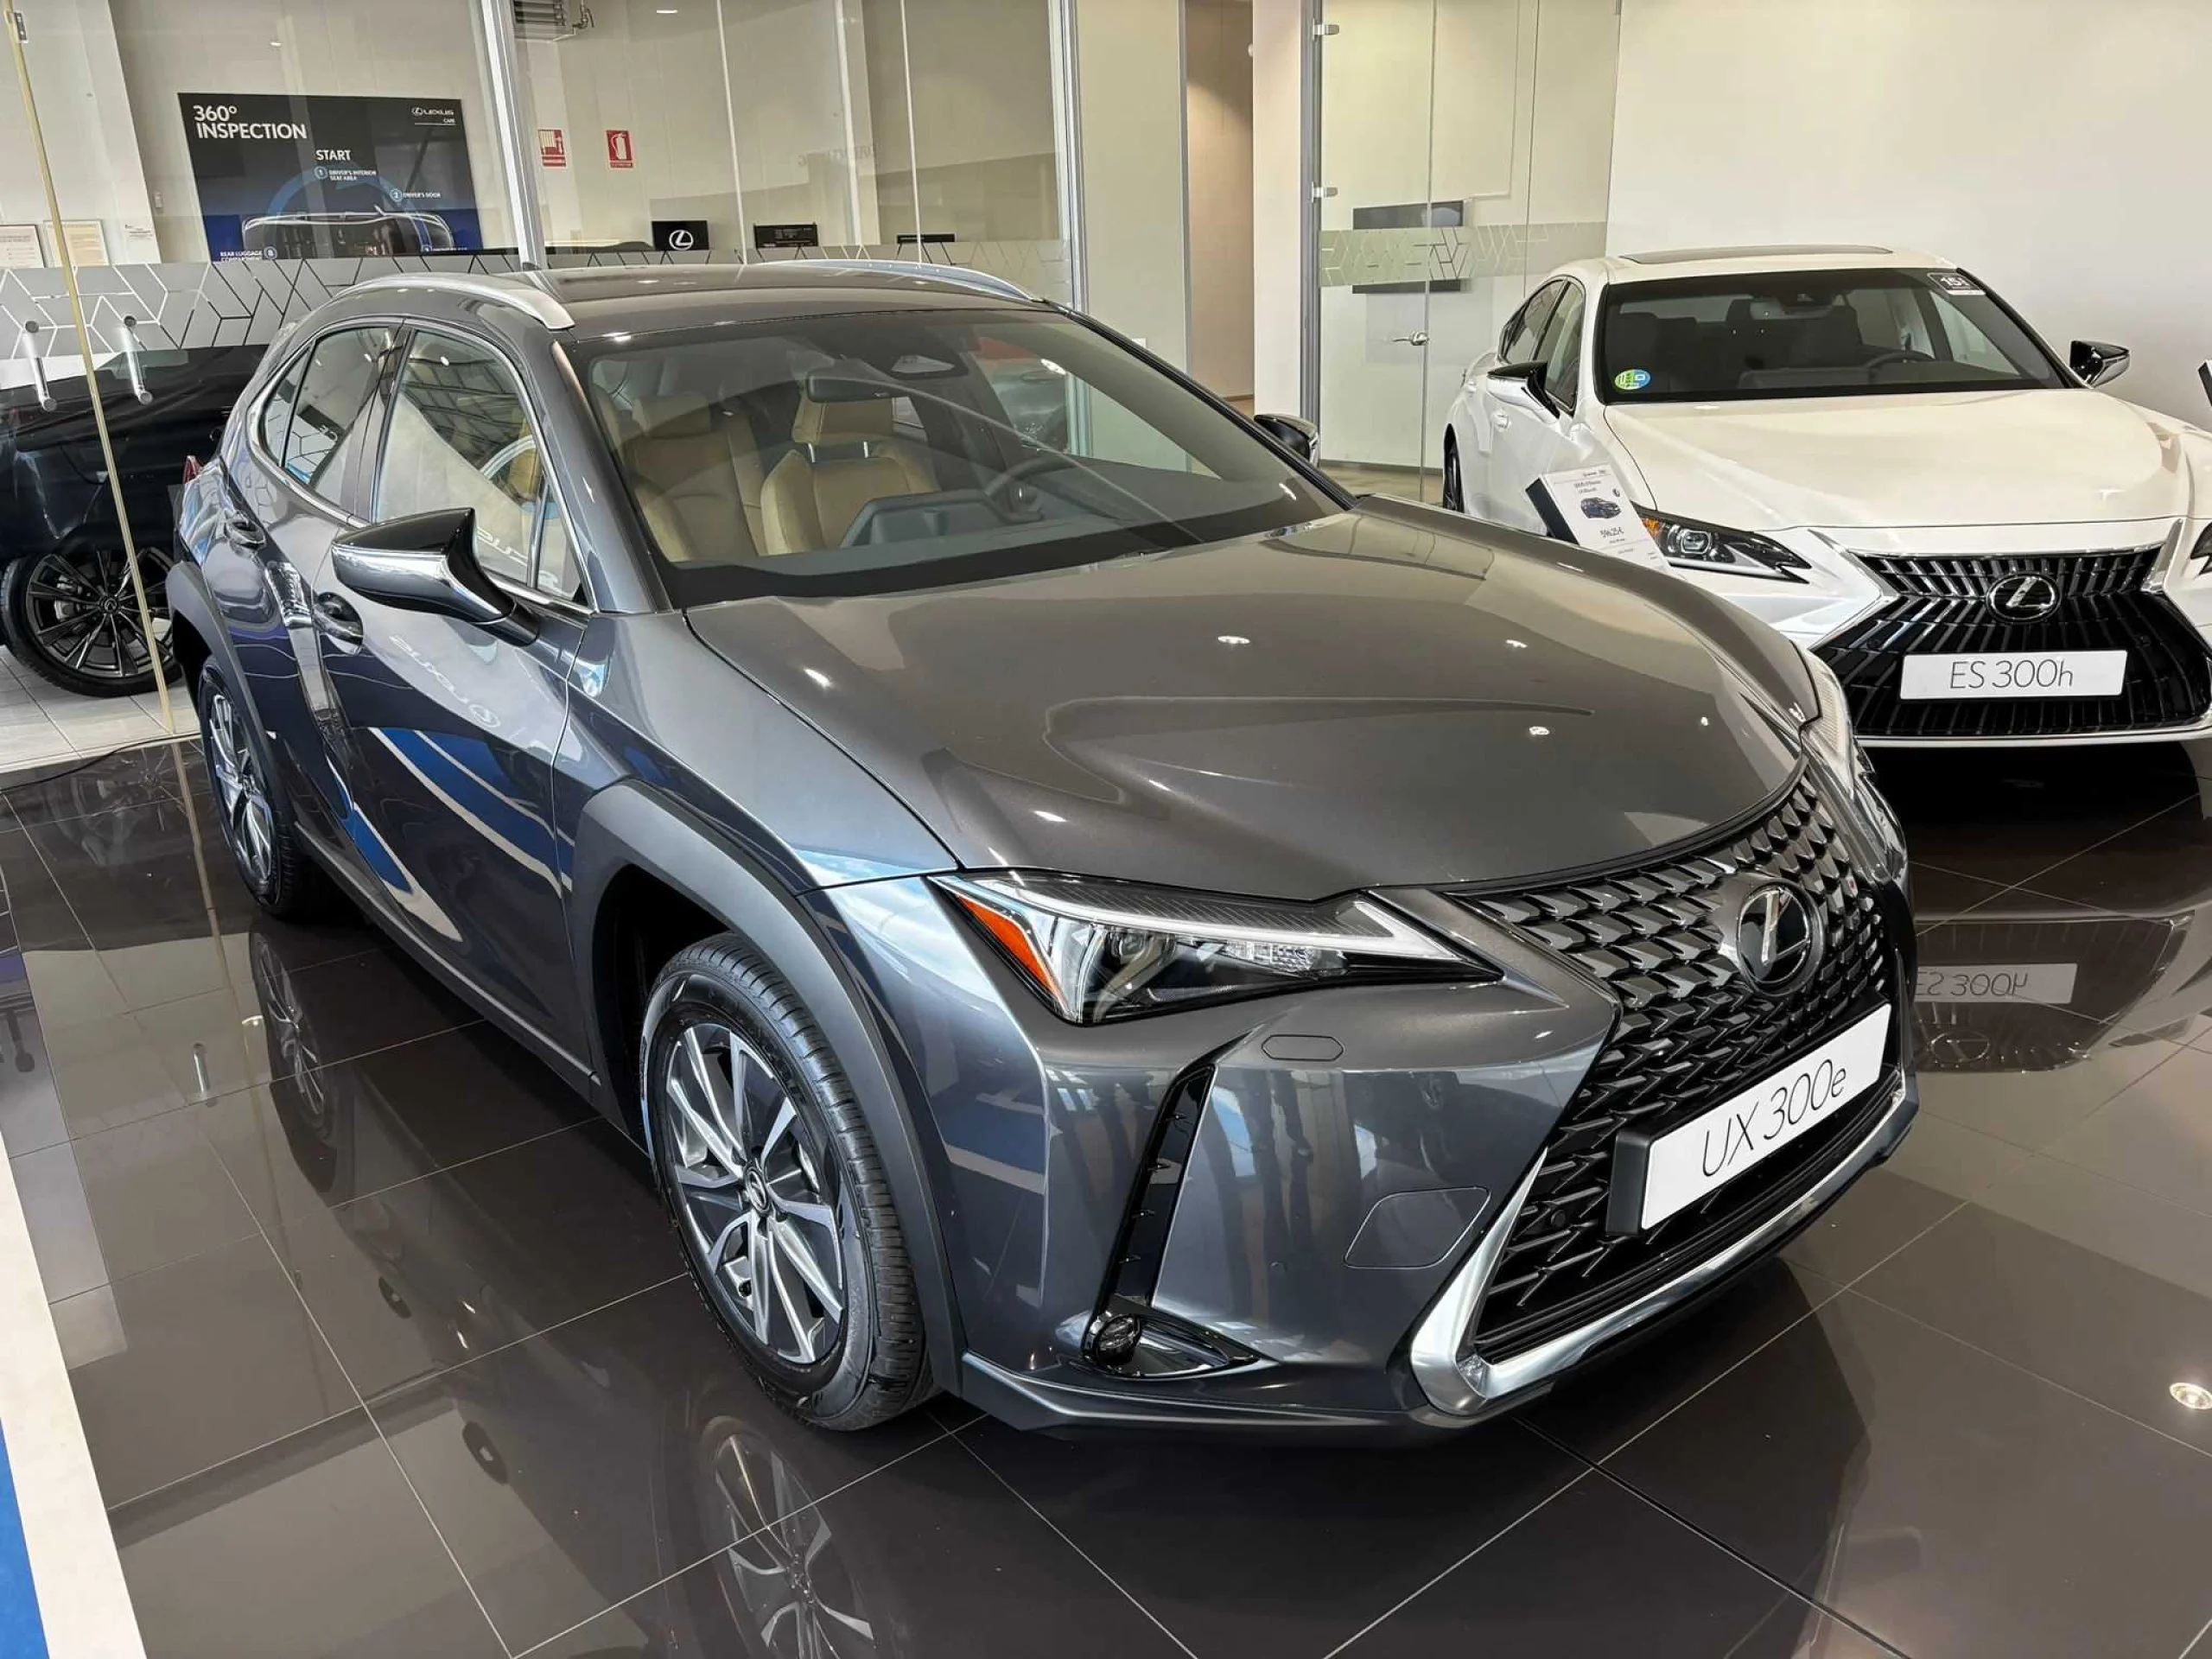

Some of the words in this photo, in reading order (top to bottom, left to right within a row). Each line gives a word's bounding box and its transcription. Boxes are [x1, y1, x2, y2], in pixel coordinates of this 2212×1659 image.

[196, 122, 308, 139] INSPECTION
[315, 149, 351, 161] START
[1949, 660, 1986, 690] ES
[1992, 658, 2074, 689] 300h
[1701, 1100, 1759, 1177] UX
[1763, 1058, 1847, 1141] 300e
